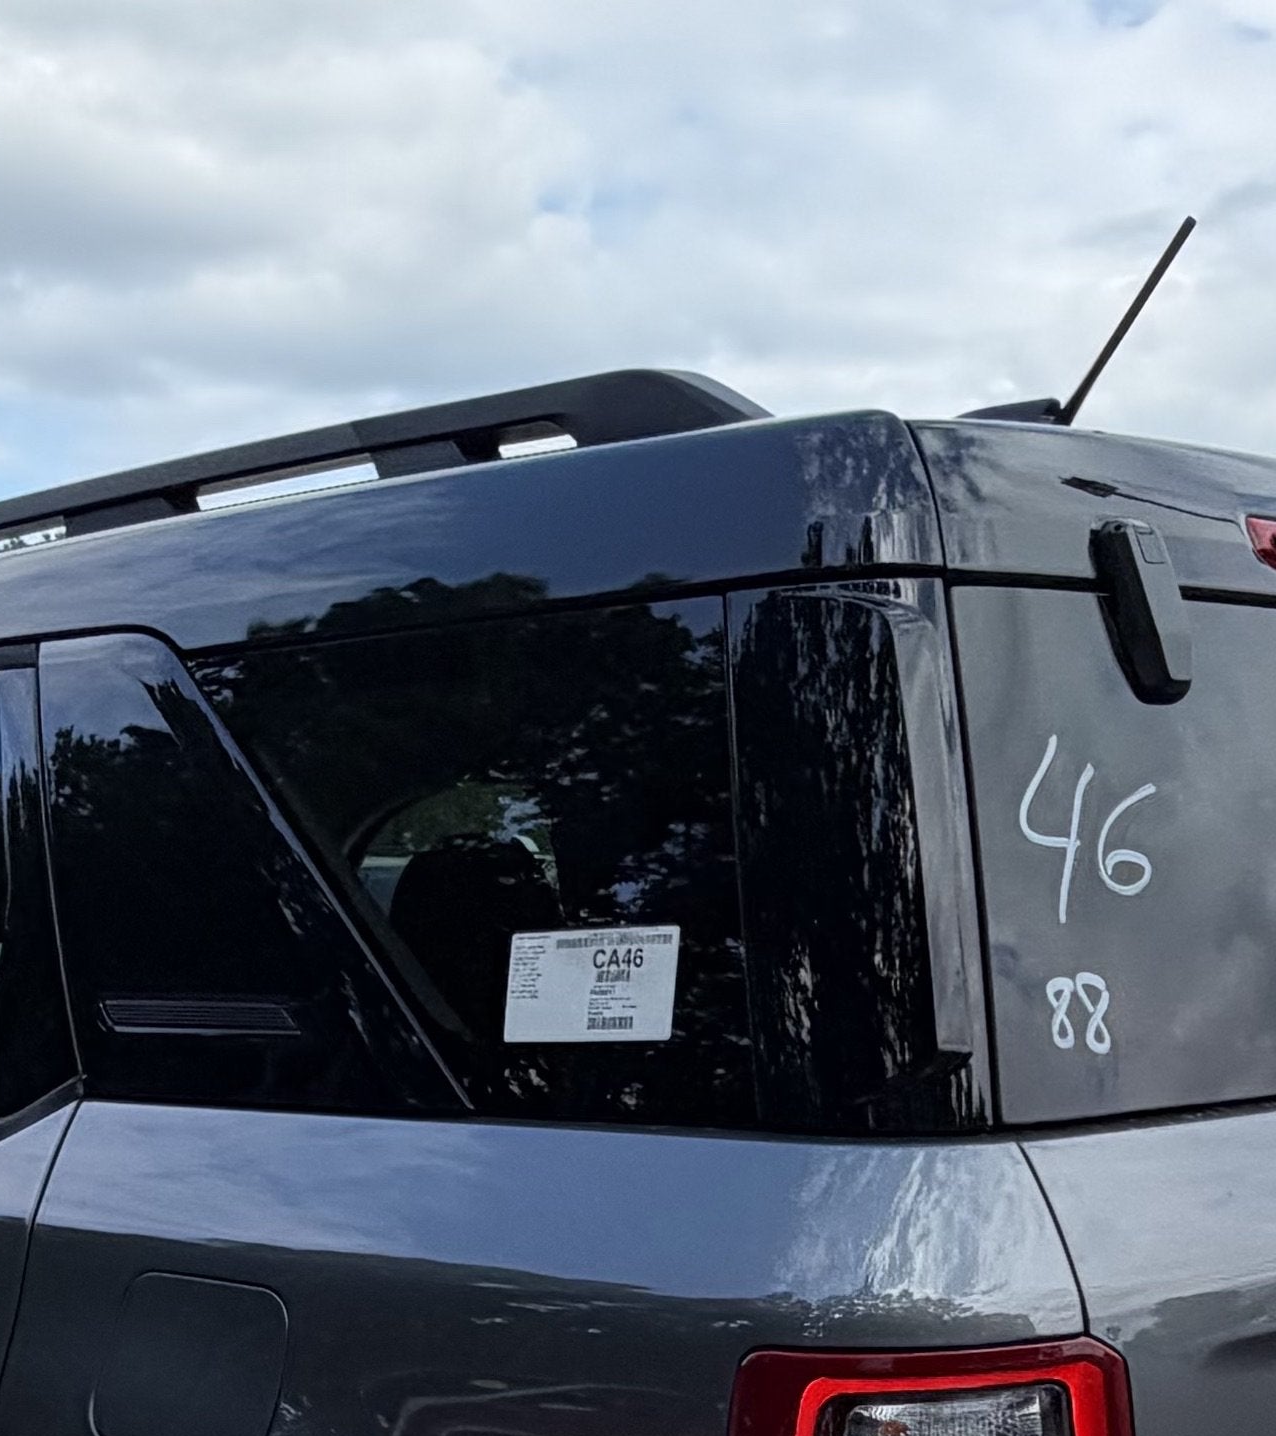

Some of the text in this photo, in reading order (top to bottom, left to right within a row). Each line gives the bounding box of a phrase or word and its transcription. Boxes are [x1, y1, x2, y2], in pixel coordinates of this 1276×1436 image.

[1018, 733, 1157, 924] 46
[592, 947, 644, 970] CA46
[1045, 971, 1112, 1055] 88
